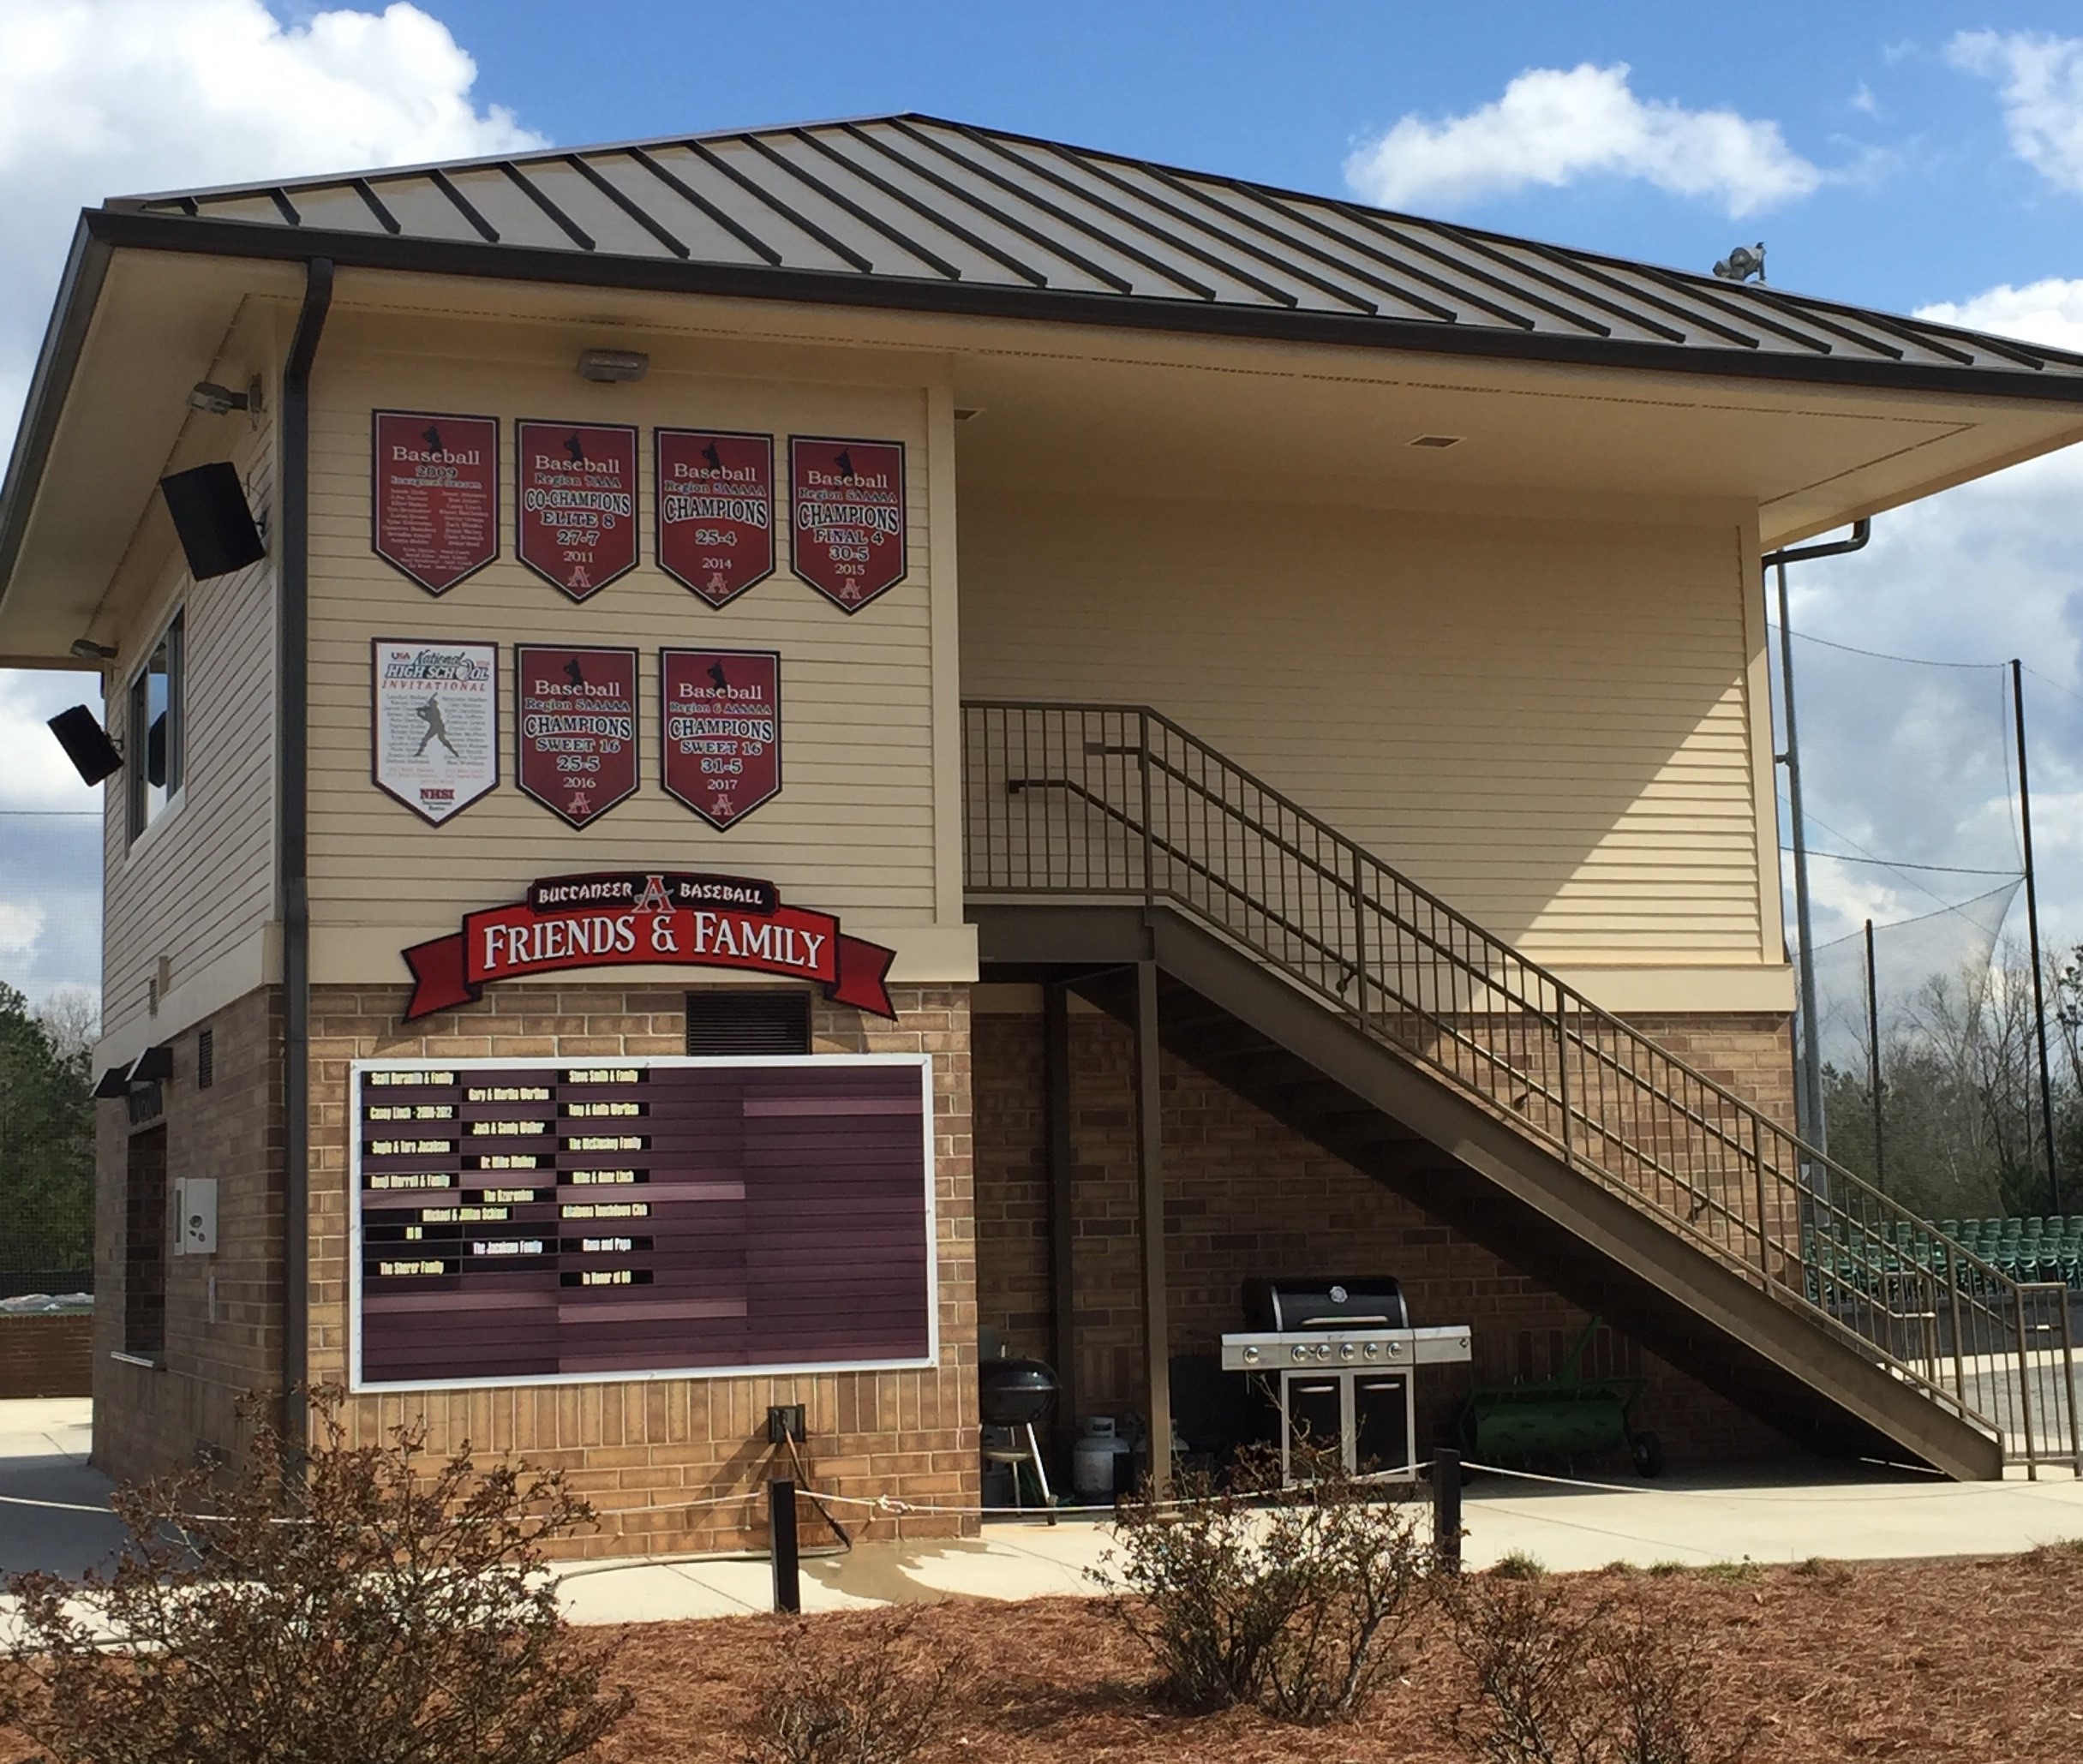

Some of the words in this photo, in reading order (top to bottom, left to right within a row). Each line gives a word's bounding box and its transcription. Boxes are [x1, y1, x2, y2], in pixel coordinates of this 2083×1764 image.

[392, 445, 481, 465] Baseball
[416, 465, 458, 479] 2009
[535, 455, 620, 474] Baseball
[673, 463, 757, 481] Baseball
[534, 472, 582, 487] Region
[664, 480, 710, 494] Region
[807, 470, 888, 488] Baseball
[524, 487, 631, 517] CO-CHAMPIONS
[798, 487, 843, 501] Region
[541, 511, 599, 528] ELITE
[602, 514, 616, 529] 8
[663, 494, 769, 529] CHAMPIONS
[798, 502, 900, 535] CHAMPIONS
[556, 529, 601, 546] 27-7
[695, 529, 738, 546] 25-4
[813, 529, 869, 545] FINAL
[871, 530, 884, 546] 4
[563, 551, 594, 563] 2011
[829, 545, 870, 561] 30-5
[703, 557, 733, 569] 2014
[835, 563, 865, 576] 2015
[411, 649, 466, 667] National
[386, 664, 425, 679] HIGH
[382, 679, 487, 692] INVITATIONAL
[535, 680, 620, 697] Baseball
[679, 683, 763, 699] Baseball
[524, 697, 572, 713] Region
[669, 701, 711, 715] Region
[524, 715, 632, 740] CHAMPIONS
[669, 716, 775, 744] CHAMPIONS
[536, 738, 596, 752] SWEET
[600, 739, 621, 753] 16
[680, 739, 739, 754] SWEET
[742, 741, 763, 756] 16
[556, 755, 601, 772] 25-5
[700, 757, 743, 774] 31-5
[563, 777, 596, 788] 2016
[707, 779, 738, 790] 2017
[420, 788, 455, 800] NHSI
[538, 882, 633, 905] BUCCANEER
[631, 875, 676, 913] A
[679, 882, 764, 905] BASEBALL
[483, 915, 636, 970] FRIENDS
[651, 915, 679, 953] &
[692, 912, 825, 969] FAMILY
